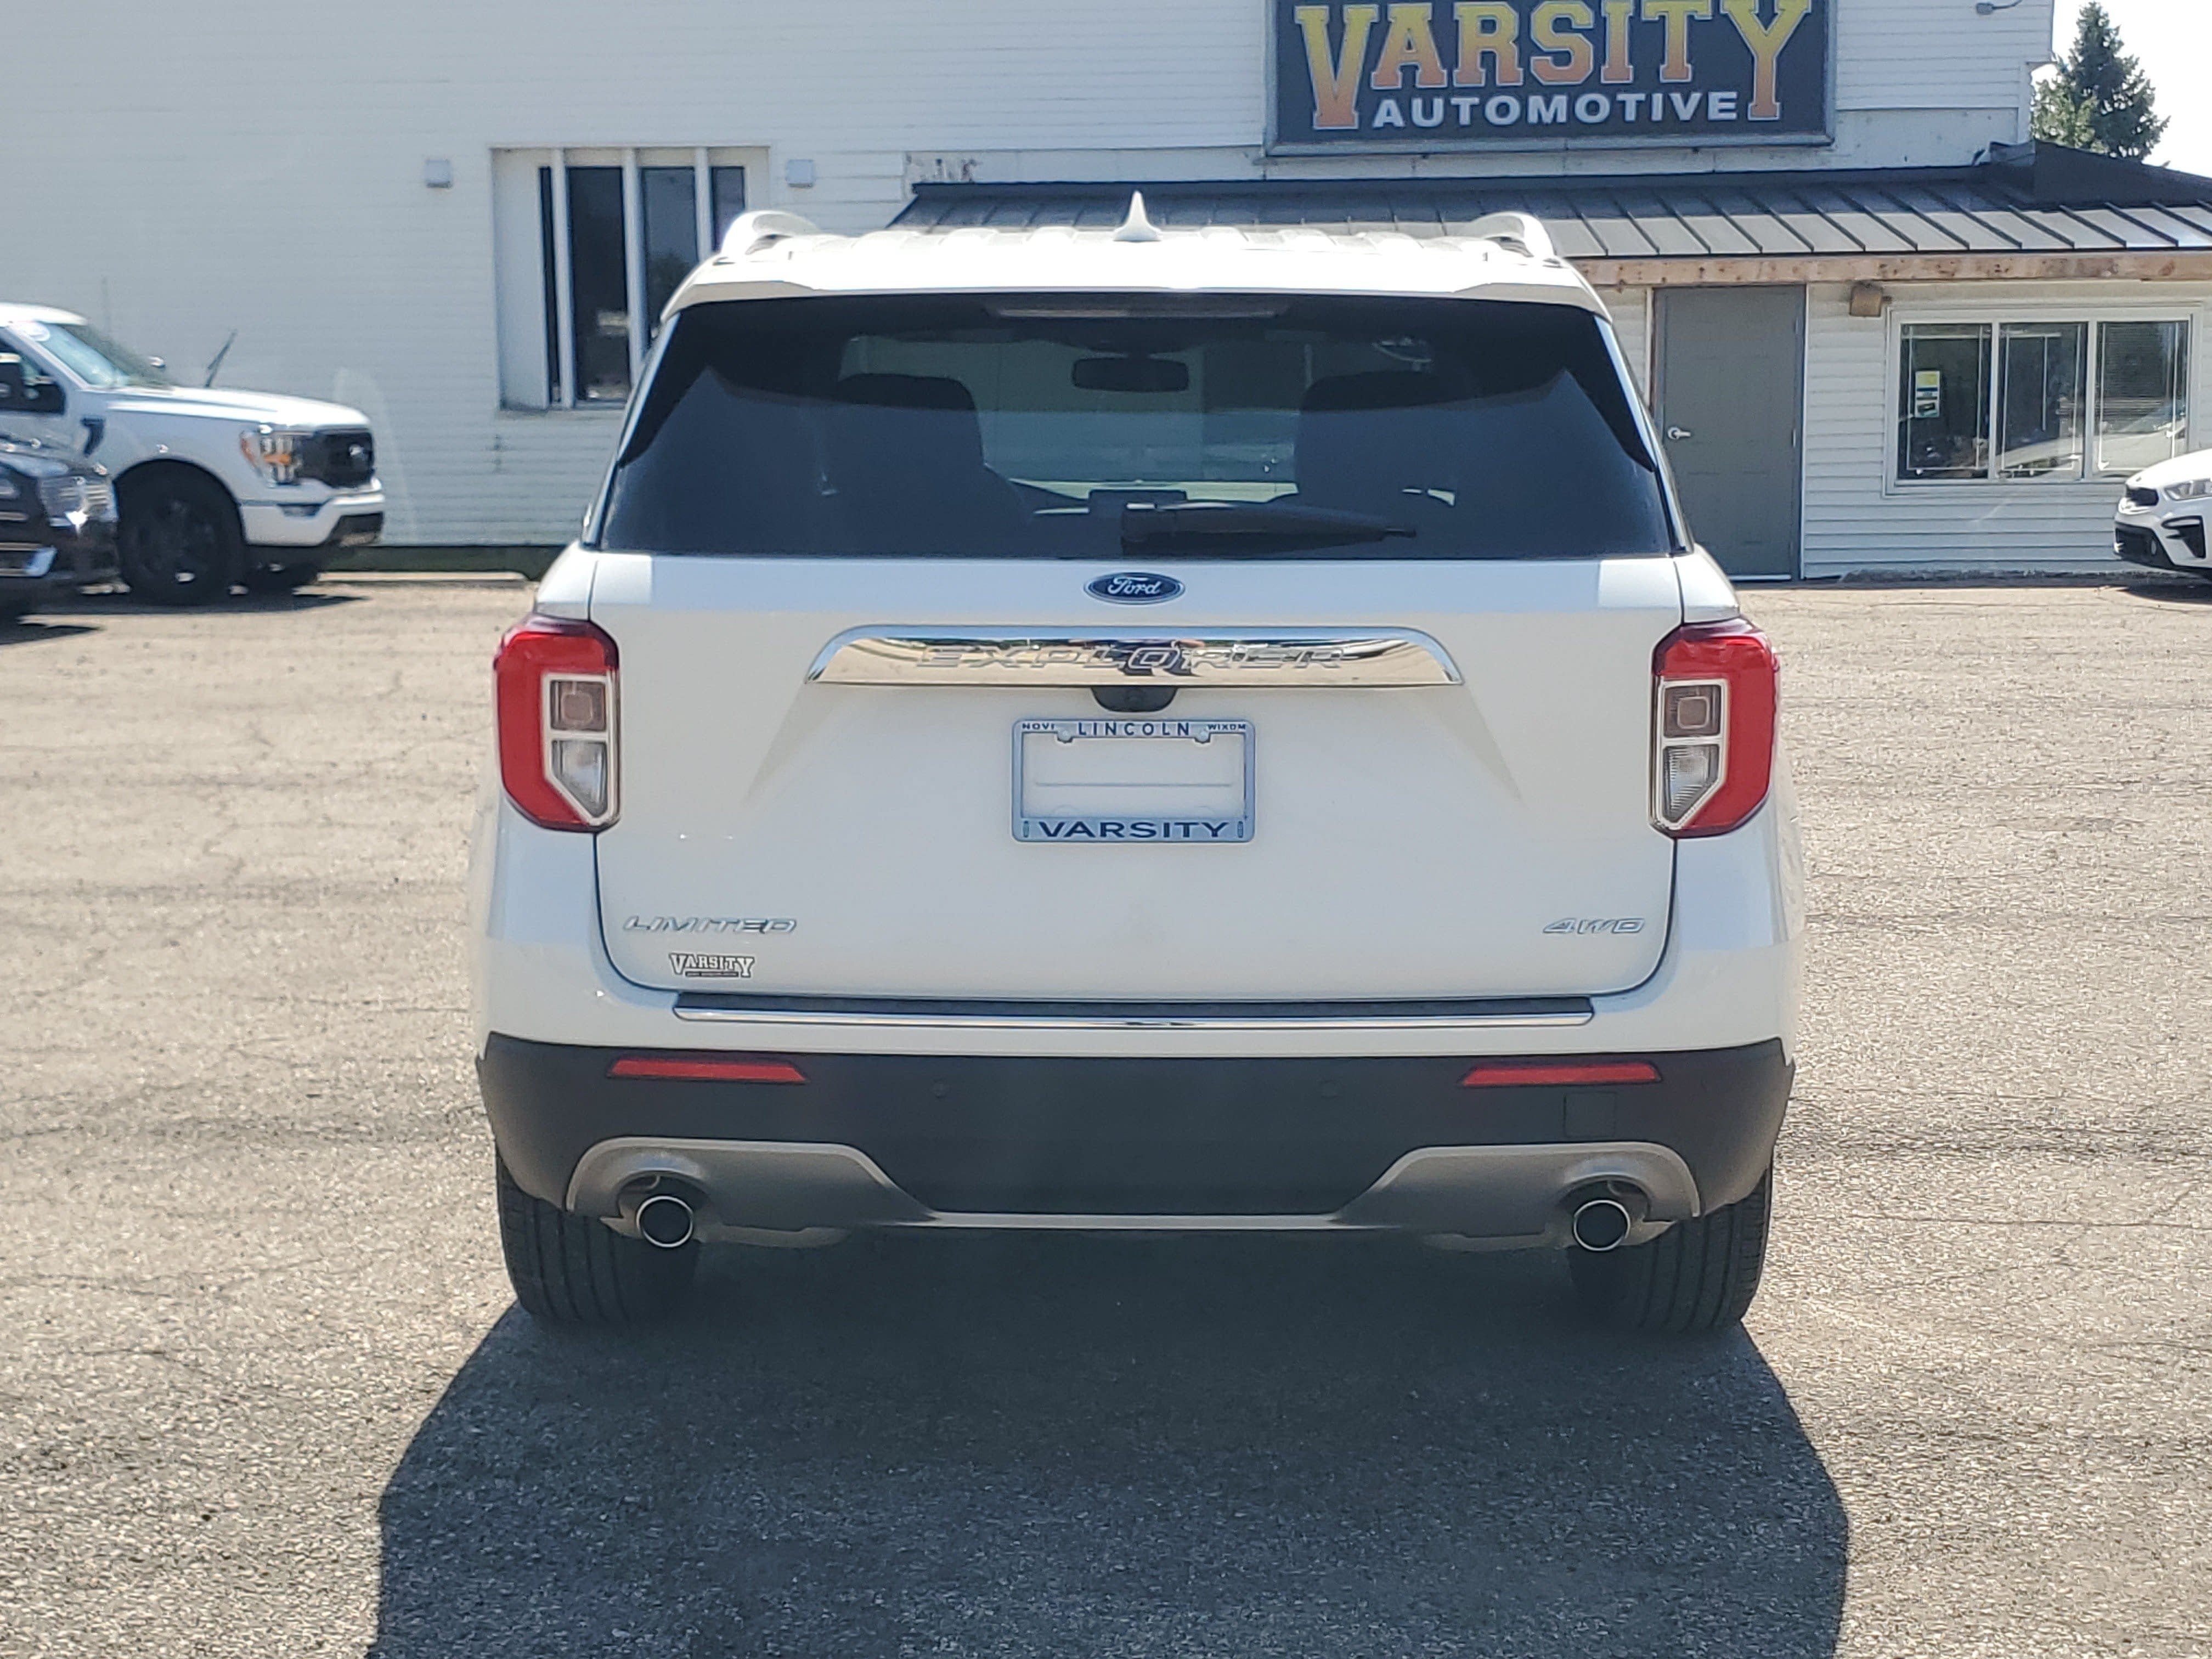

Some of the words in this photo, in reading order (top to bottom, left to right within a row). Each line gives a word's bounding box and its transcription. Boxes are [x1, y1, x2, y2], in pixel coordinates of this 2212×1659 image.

[1294, 0, 1811, 130] VARSITY
[1373, 91, 1738, 127] AUTOMOTIVE
[1108, 577, 1162, 594] Ford
[916, 646, 1343, 668] EXPLORER
[1078, 722, 1189, 736] LINCOLN
[1039, 821, 1229, 838] VARSITY
[623, 916, 797, 933] LIMITED
[1543, 917, 1645, 934] 4WD
[669, 953, 755, 978] VARSITY
